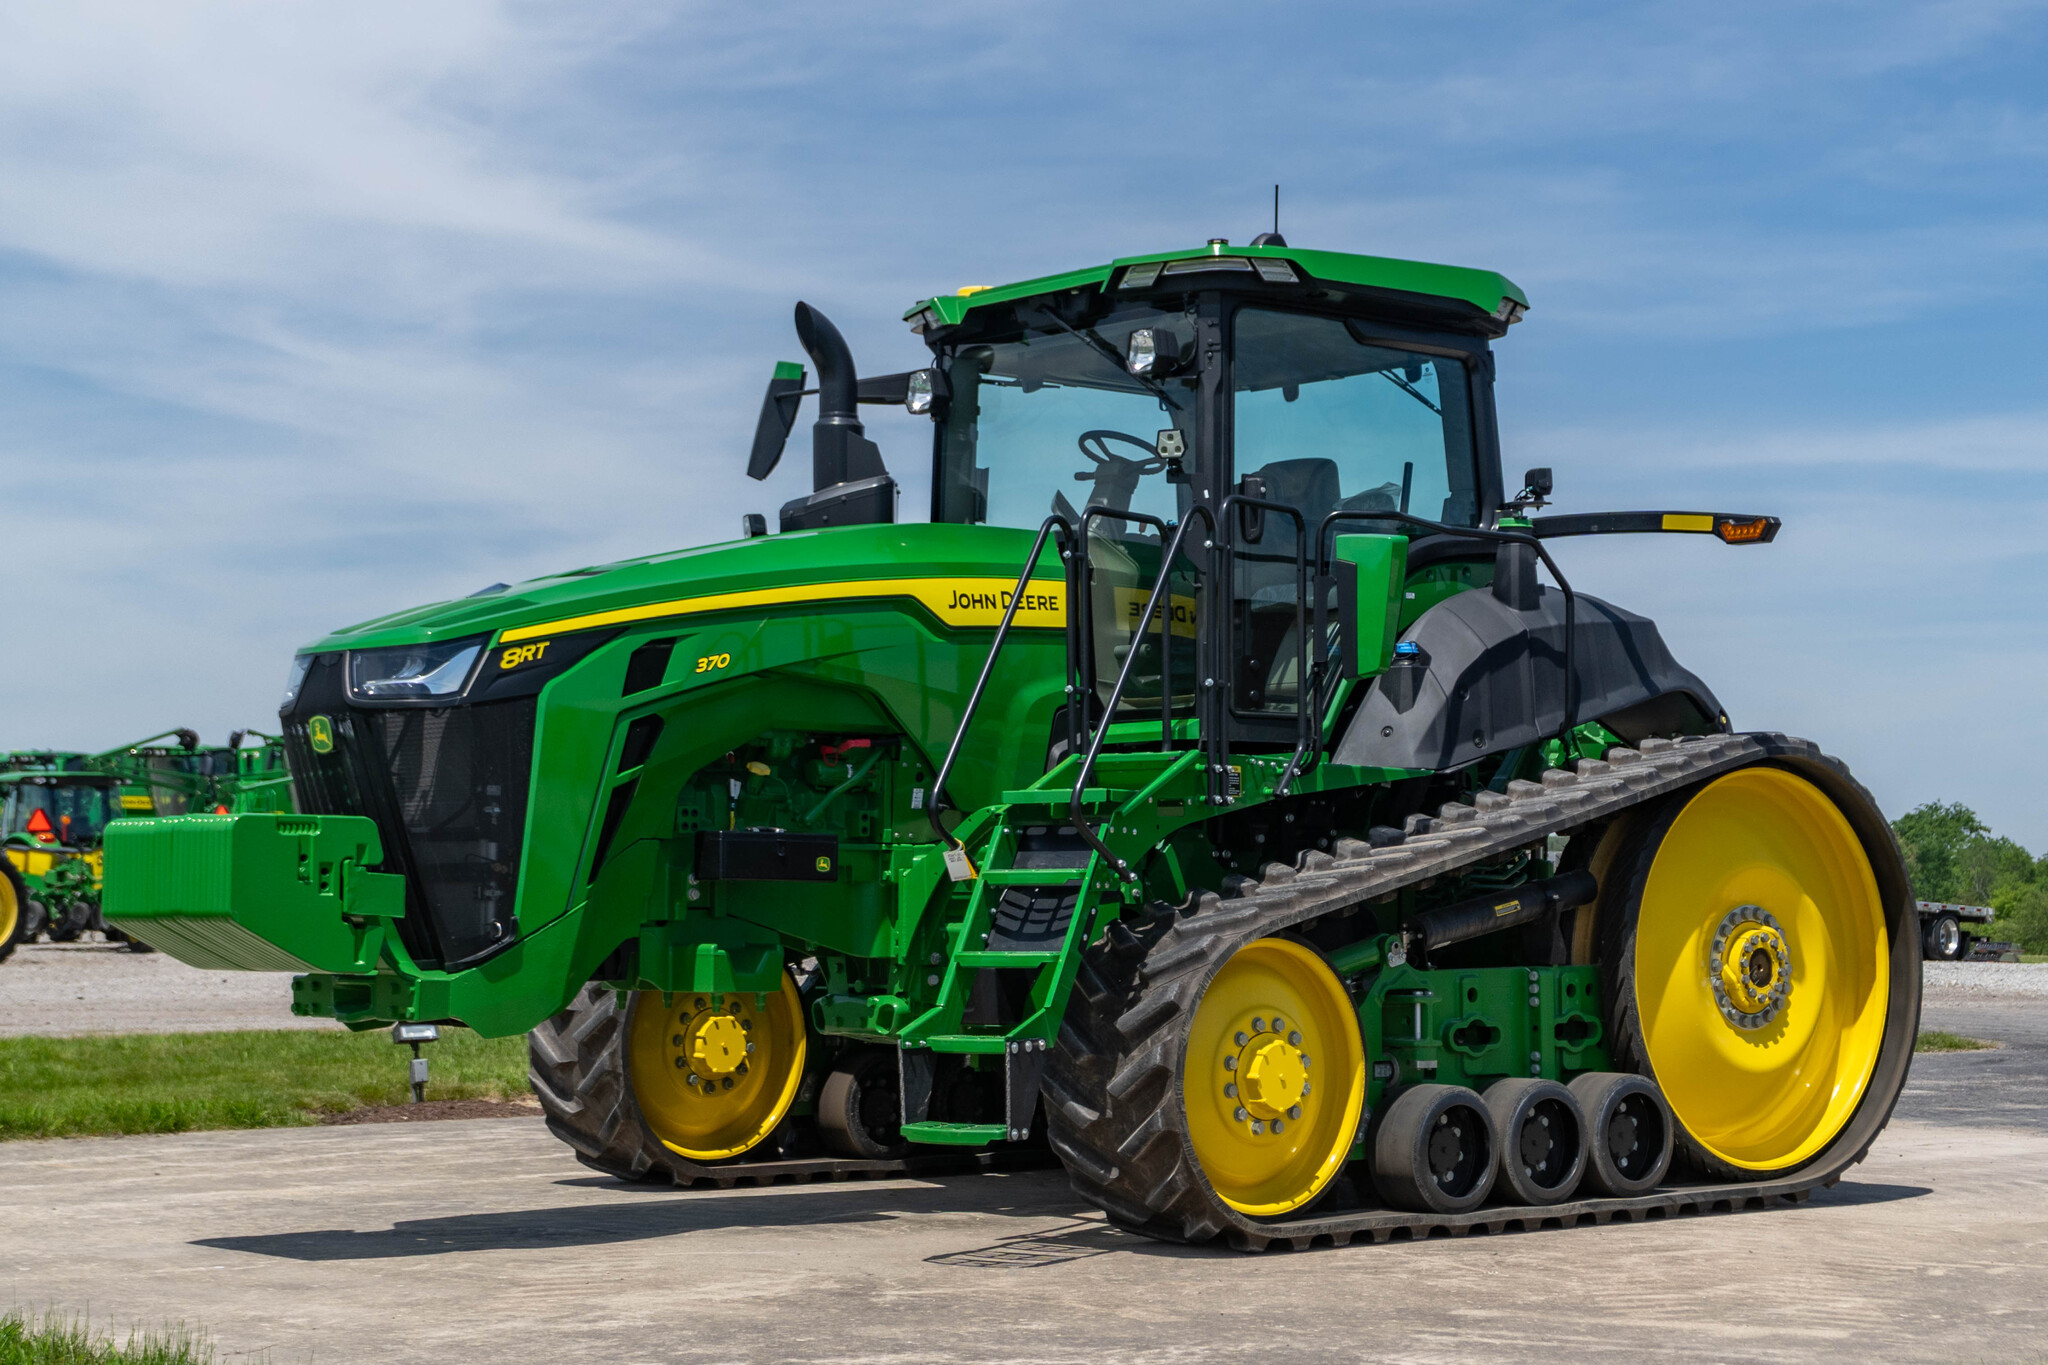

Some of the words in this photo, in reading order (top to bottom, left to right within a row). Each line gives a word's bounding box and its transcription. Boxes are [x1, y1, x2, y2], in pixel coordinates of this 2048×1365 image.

[948, 590, 997, 610] JOHN
[500, 641, 550, 670] 8RT
[695, 653, 731, 674] 370
